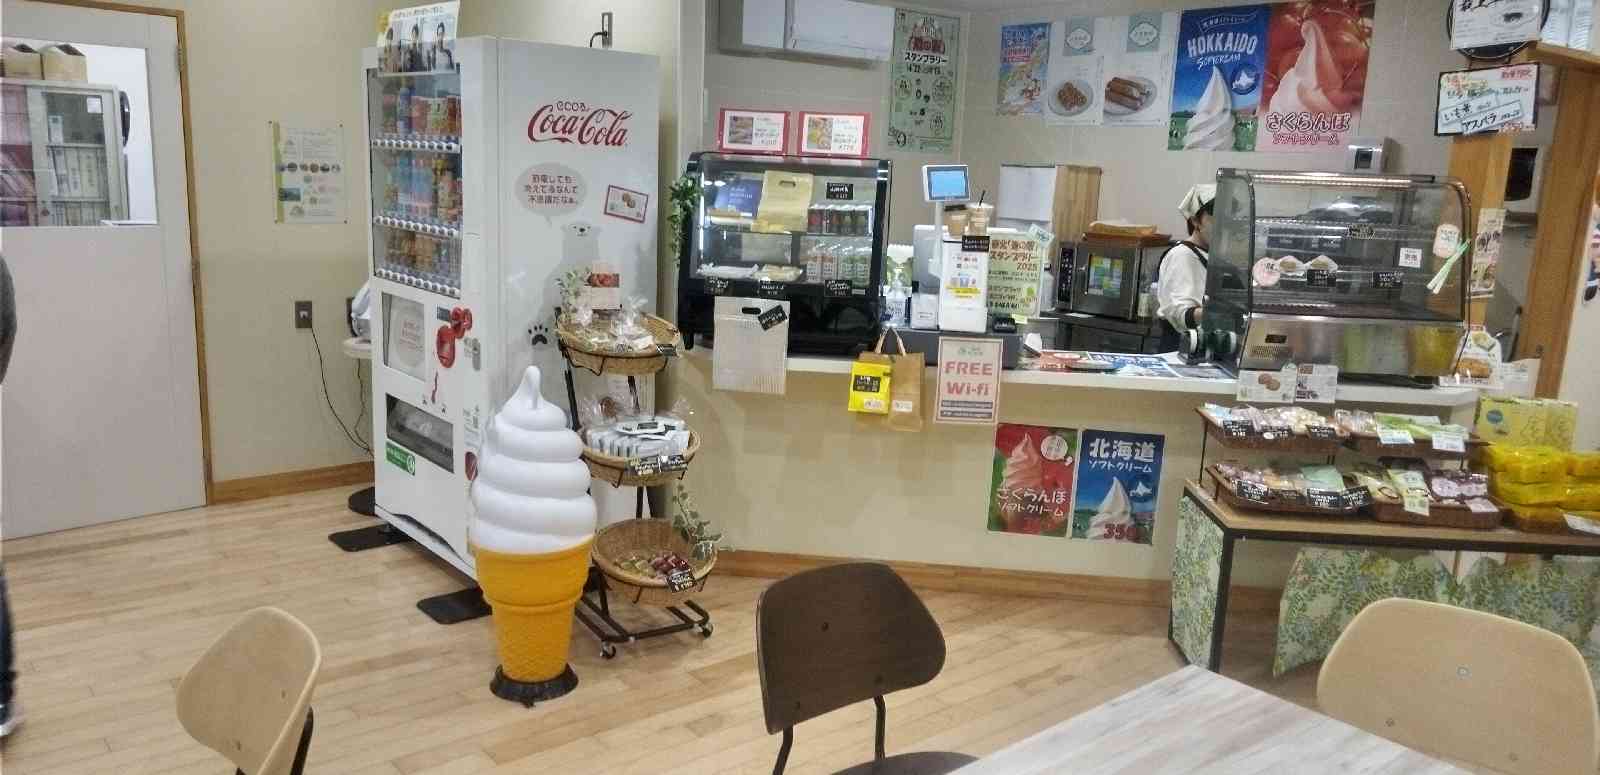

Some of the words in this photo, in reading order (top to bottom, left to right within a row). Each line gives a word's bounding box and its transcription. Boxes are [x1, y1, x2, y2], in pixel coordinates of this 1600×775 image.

[1187, 32, 1258, 57] HOKKAIDO
[527, 104, 633, 146] Coca-Cola
[1266, 111, 1351, 132] さくらんぼ
[1461, 112, 1497, 130] アスパラ
[1016, 262, 1038, 271] 2025
[944, 361, 993, 376] FREE
[946, 381, 990, 396] Wi-fi
[1089, 437, 1156, 463] 北海道
[1088, 459, 1153, 473] ソフトクリーム
[997, 486, 1067, 504] さくらんぼ
[998, 502, 1064, 517] ソフトクリーム
